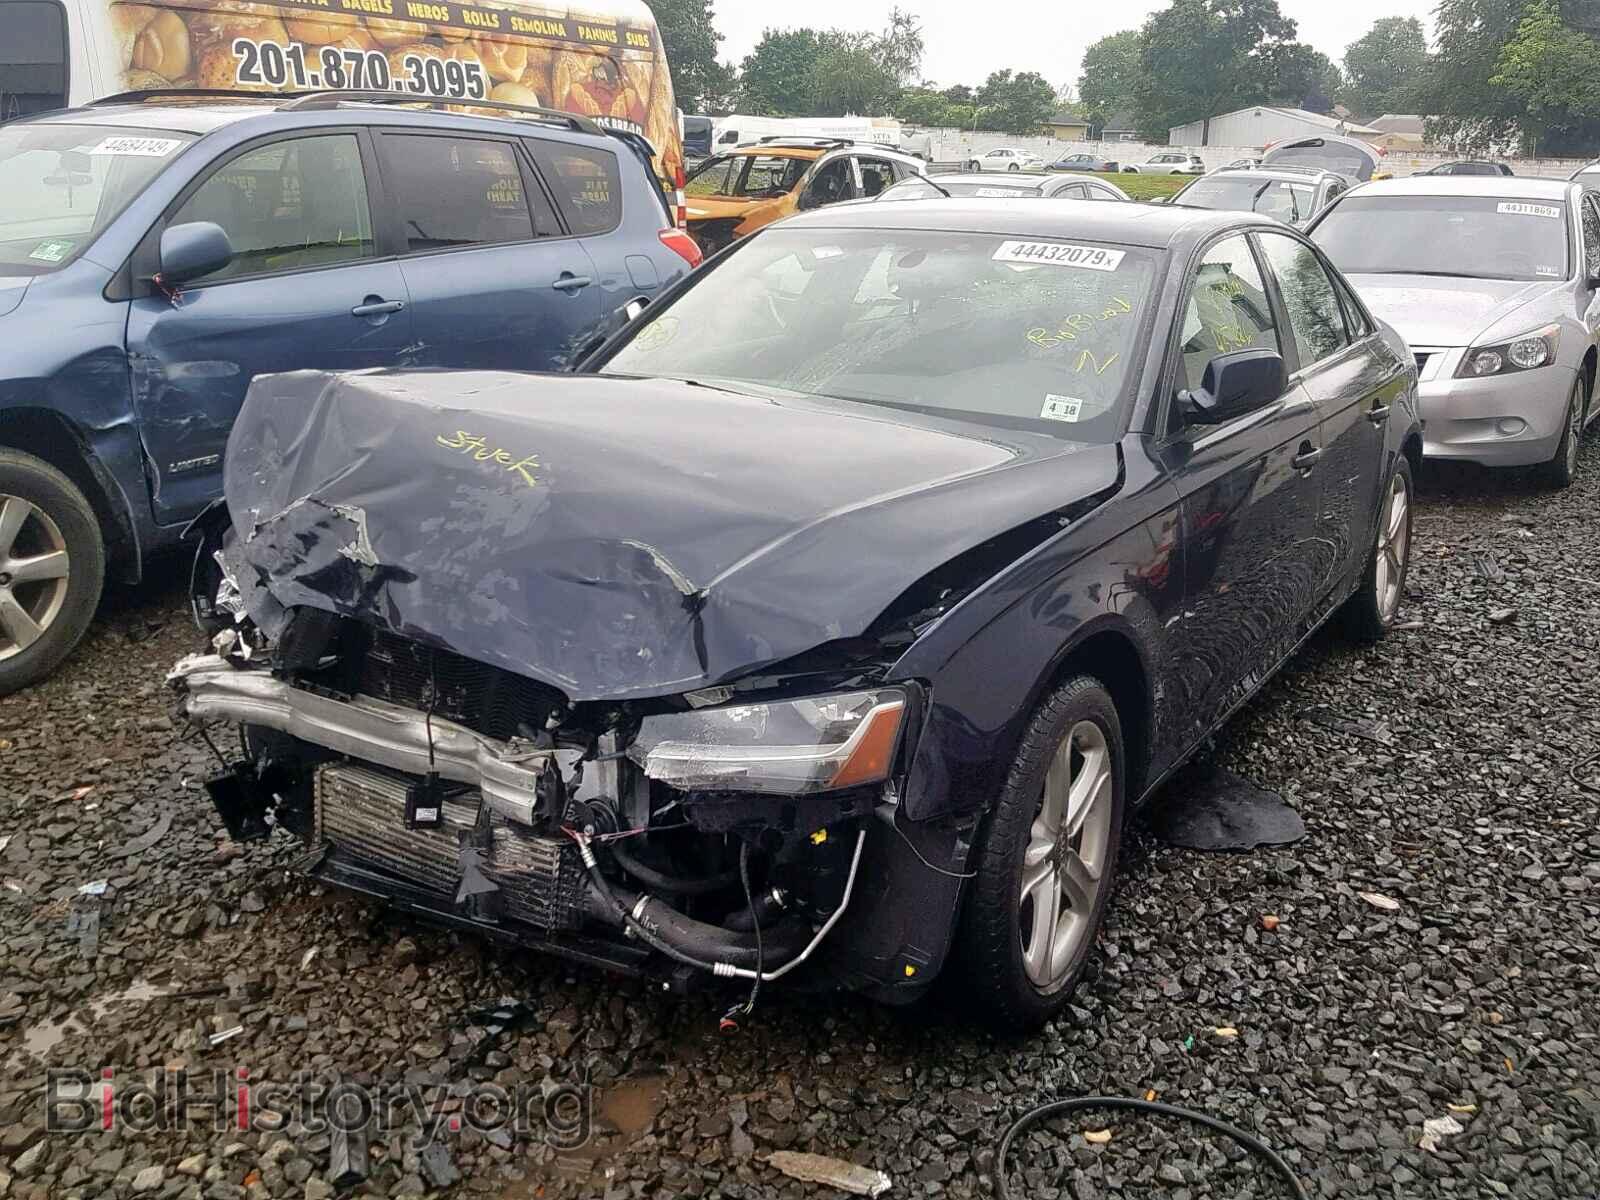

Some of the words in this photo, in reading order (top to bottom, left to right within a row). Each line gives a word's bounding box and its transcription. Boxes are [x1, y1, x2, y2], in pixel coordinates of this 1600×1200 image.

[407, 2, 450, 21] HEROS
[462, 9, 500, 28] ROLLS
[511, 17, 566, 37] SEMOLINA
[577, 26, 618, 43] PANINIS
[626, 32, 650, 48] SUBS
[233, 39, 486, 99] 201.870.3095
[1048, 402, 1057, 413] 4
[1063, 404, 1077, 416] 18
